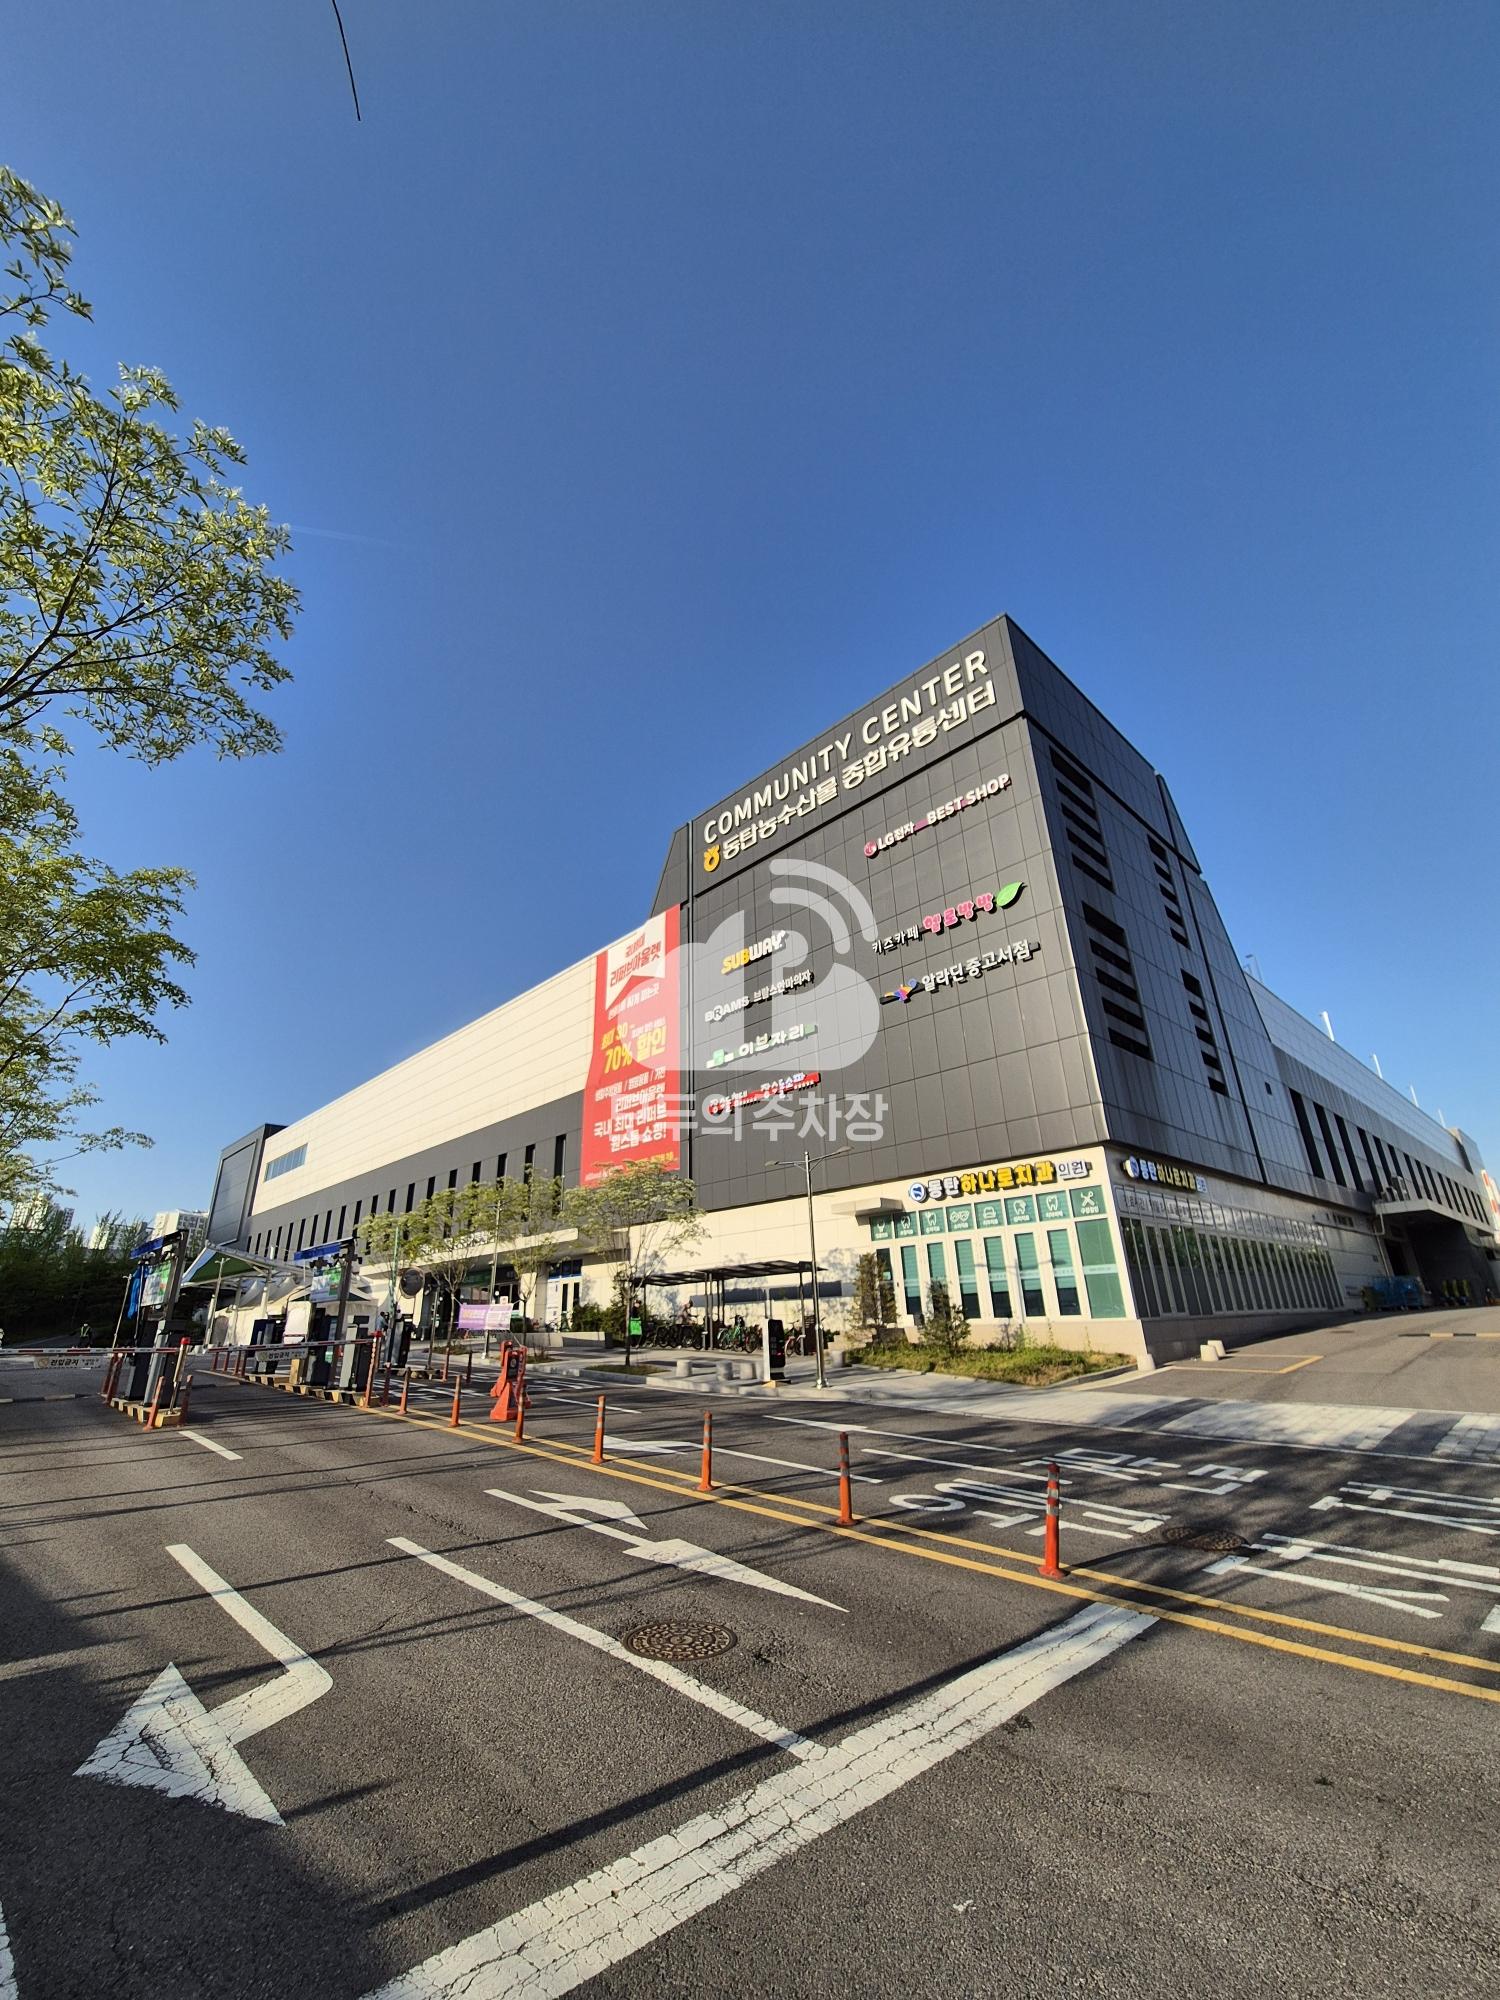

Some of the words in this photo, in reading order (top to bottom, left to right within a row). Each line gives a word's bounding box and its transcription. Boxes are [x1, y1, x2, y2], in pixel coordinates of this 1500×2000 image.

[703, 733, 852, 844] COMMUNITY
[861, 650, 988, 745] CENTER
[722, 776, 839, 861] 동탄농수산물
[841, 681, 997, 790] 종합유통센터
[877, 822, 914, 851] LG전자
[926, 796, 964, 825] BEST
[966, 773, 1010, 805] SHOP
[720, 931, 786, 975] SUBWAY
[872, 925, 920, 954] 키즈카페
[921, 963, 964, 992] 알라딘
[965, 939, 1031, 977] 중고서점
[604, 1042, 633, 1074] 70%
[636, 1025, 667, 1063] 할인
[738, 1023, 804, 1057] 이브자리
[594, 1118, 613, 1138] 국내
